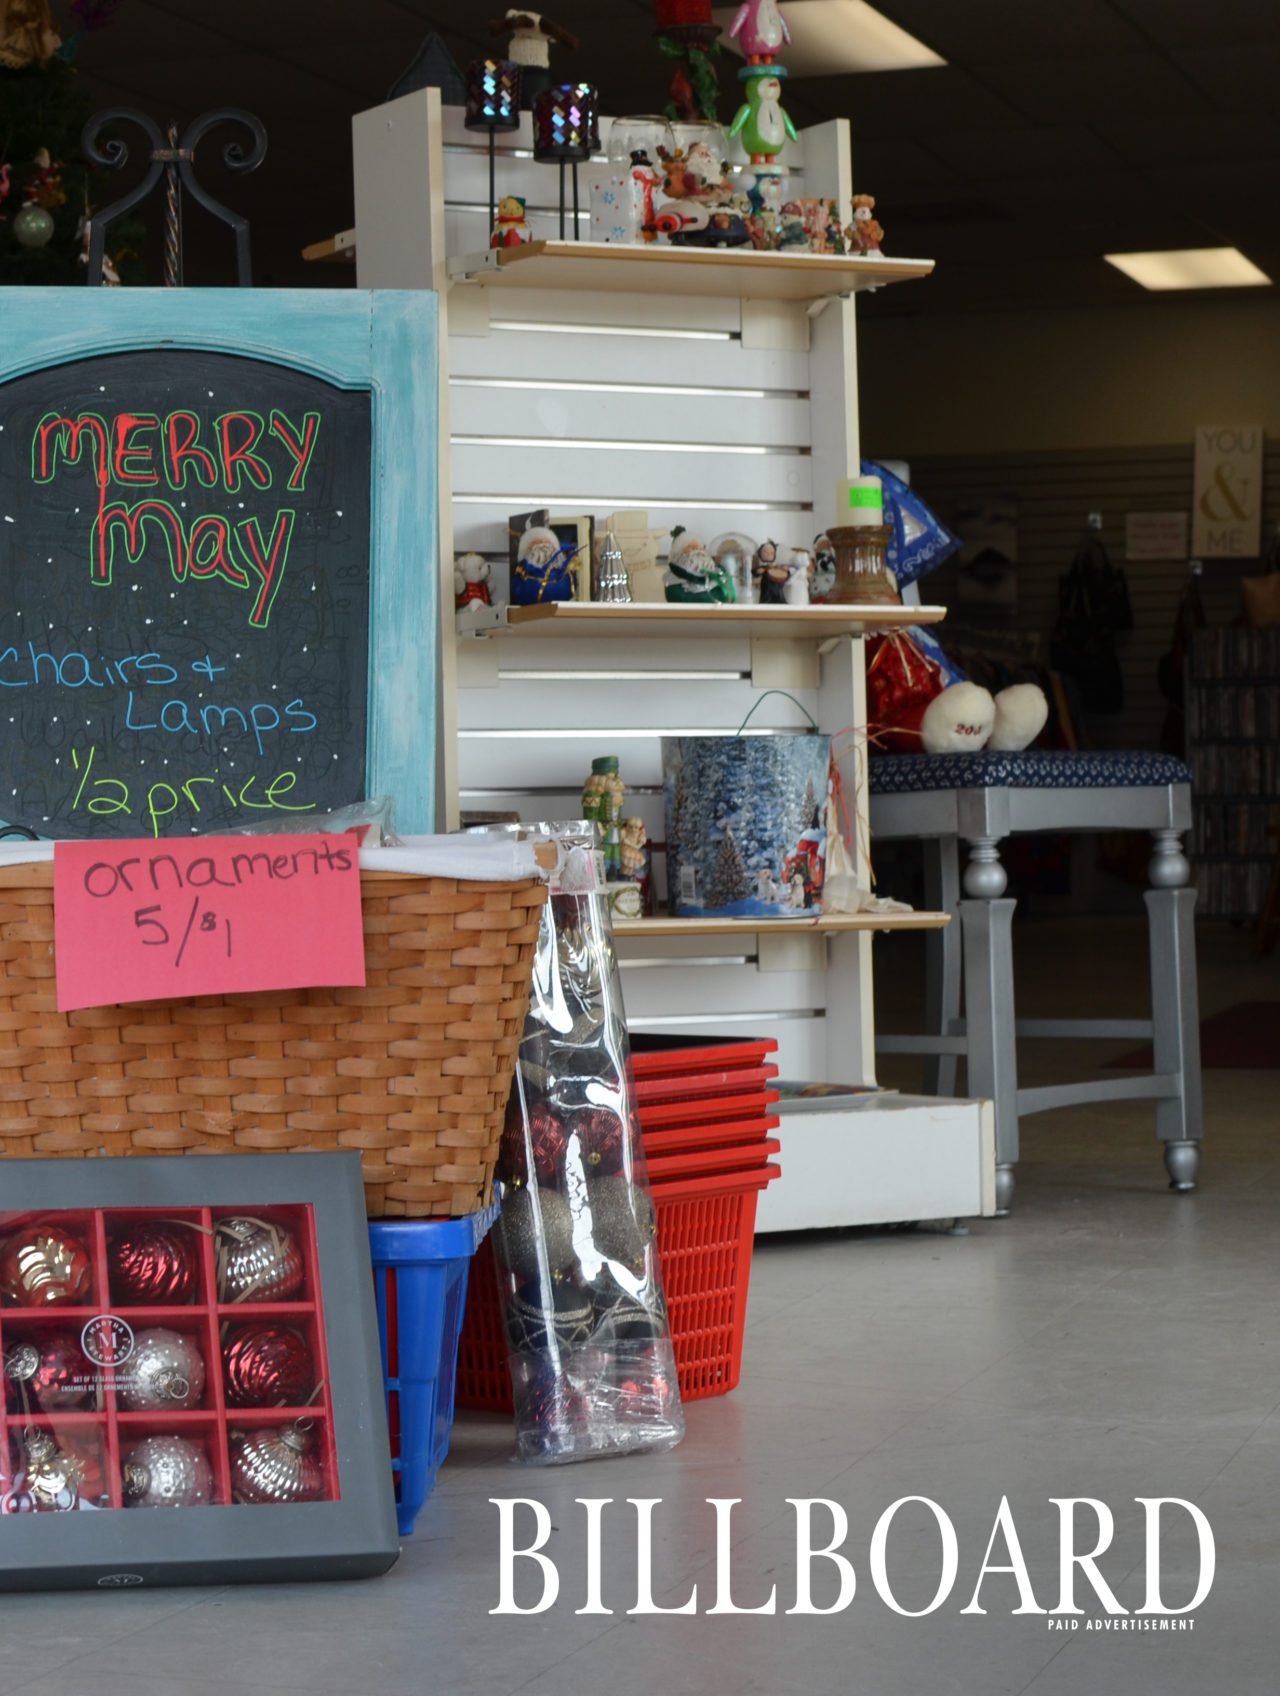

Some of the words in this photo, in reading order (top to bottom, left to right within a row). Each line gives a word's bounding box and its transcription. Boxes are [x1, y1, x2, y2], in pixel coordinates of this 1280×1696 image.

[32, 410, 320, 491] MERRY
[1202, 430, 1257, 454] YOU
[1199, 462, 1255, 522] &
[1207, 529, 1244, 553] ME
[125, 690, 318, 755] Lamps
[145, 768, 317, 838] price
[83, 840, 353, 898] ornaments
[89, 1320, 124, 1335] MARTHA
